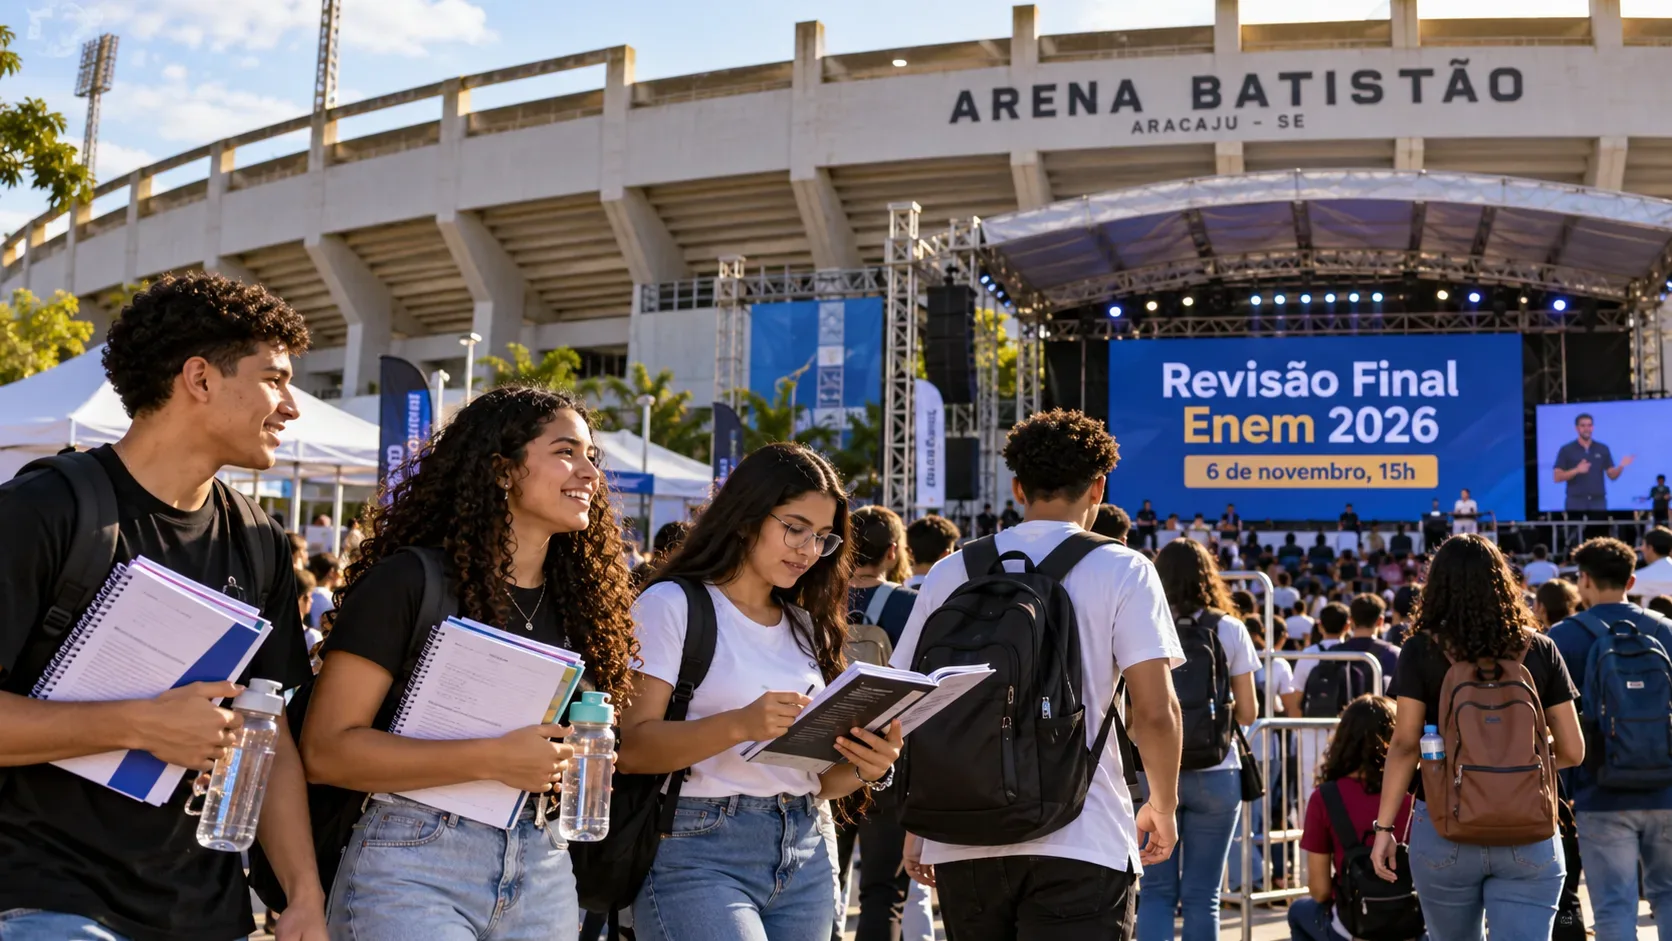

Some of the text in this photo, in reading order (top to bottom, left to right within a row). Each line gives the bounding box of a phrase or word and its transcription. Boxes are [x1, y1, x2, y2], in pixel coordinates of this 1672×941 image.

[949, 58, 1524, 124] ARENA BATISTÃO
[1131, 116, 1238, 134] ARACAJU
[1278, 114, 1305, 129] SE
[1163, 359, 1459, 398] Revisão Final
[1184, 406, 1439, 444] Enem 2026
[1206, 462, 1416, 484] 6 de novembro, 15h
